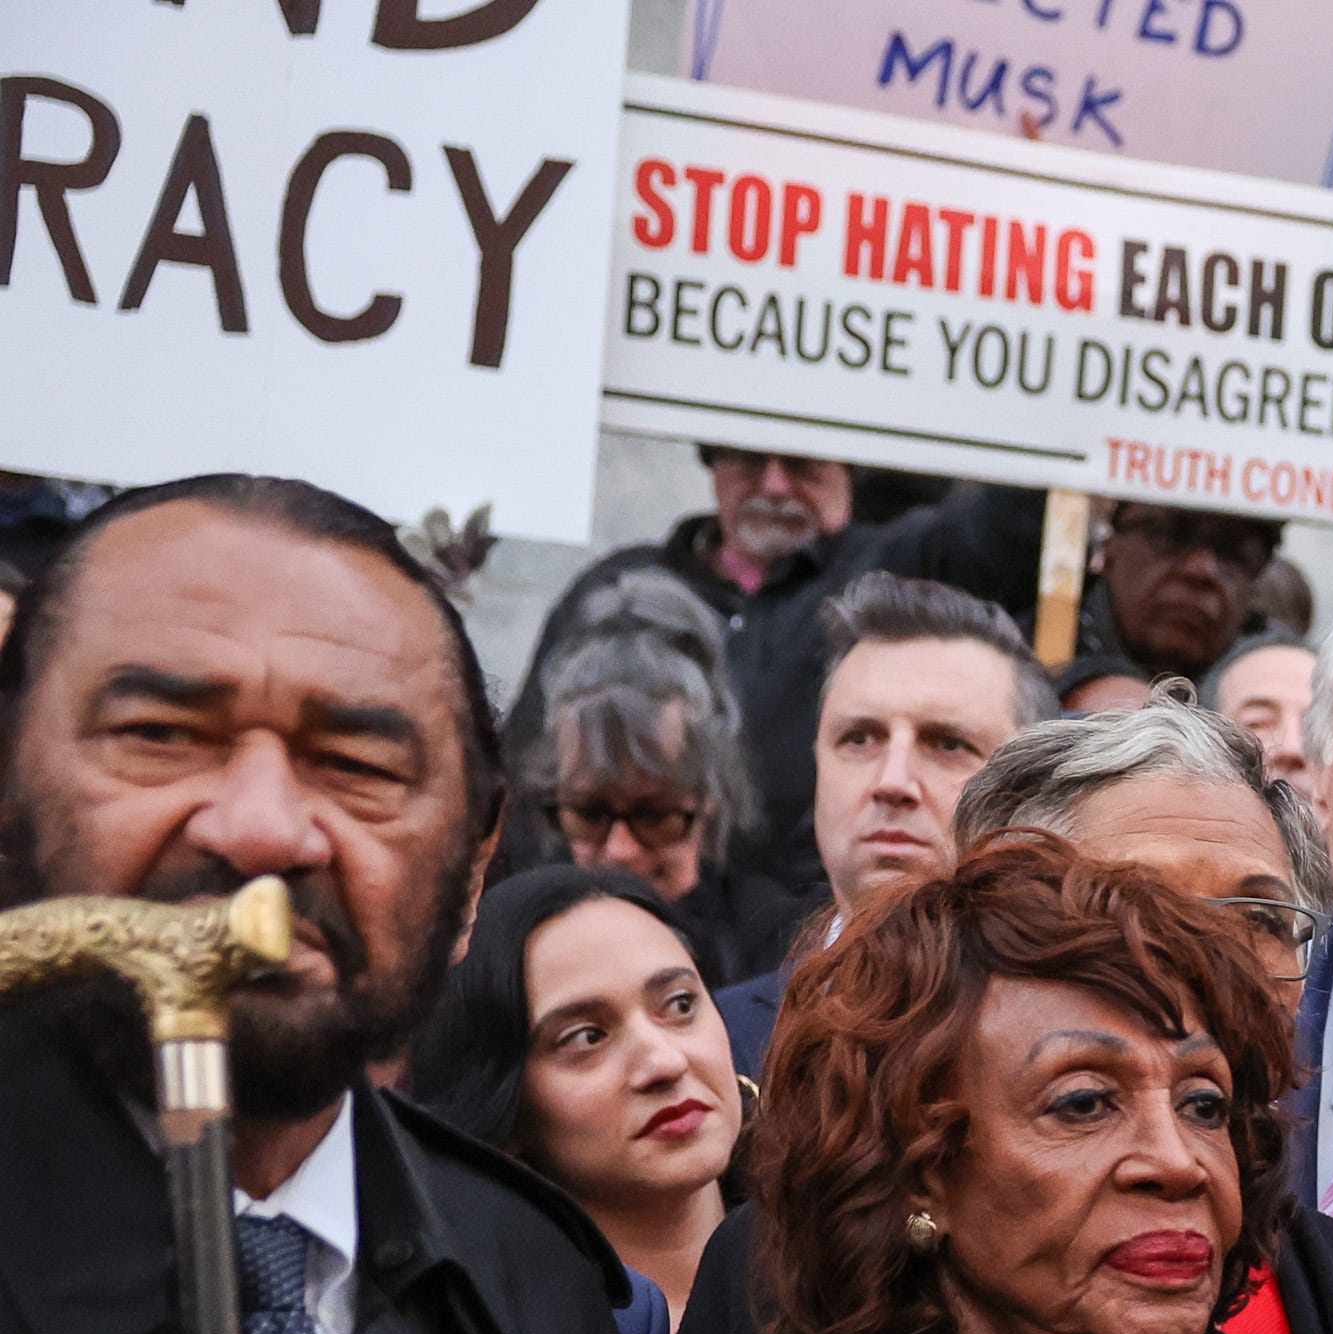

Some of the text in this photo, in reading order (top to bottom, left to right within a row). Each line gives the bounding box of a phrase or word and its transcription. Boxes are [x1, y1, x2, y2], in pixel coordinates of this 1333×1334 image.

[880, 31, 1125, 147] MUSK
[0, 74, 574, 369] RACY
[633, 159, 823, 266] STOP
[842, 191, 1096, 312] HATING
[1119, 240, 1288, 341] EACH
[625, 272, 910, 375] BECAUSE
[940, 320, 1055, 397] YOU
[1104, 437, 1231, 494] TRUTH
